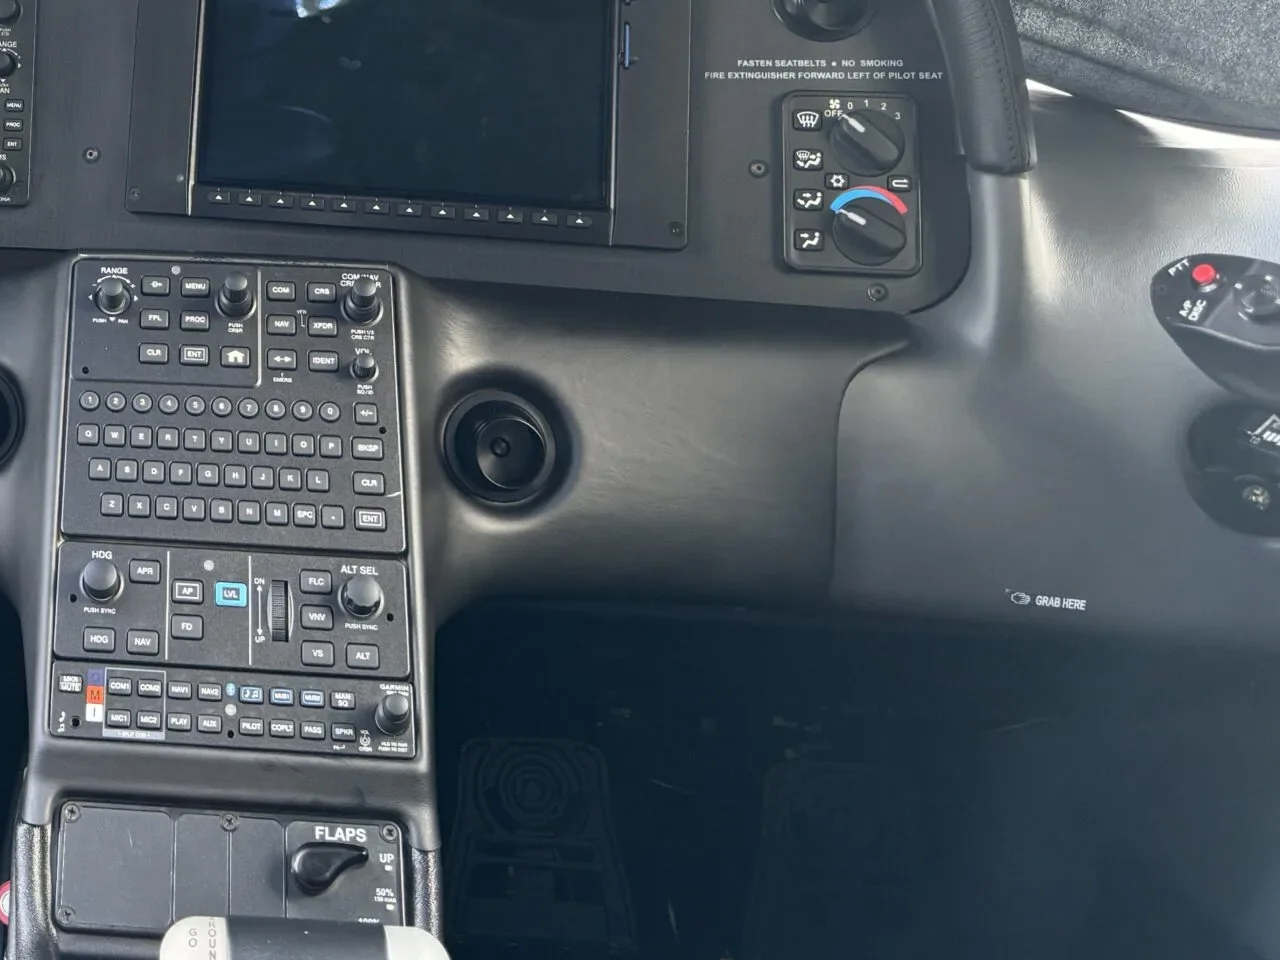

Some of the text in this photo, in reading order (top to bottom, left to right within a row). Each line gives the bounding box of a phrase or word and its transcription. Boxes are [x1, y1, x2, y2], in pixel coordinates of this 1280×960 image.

[847, 102, 853, 110] 0
[895, 112, 901, 120] 3
[1168, 259, 1189, 276] PTT
[1188, 300, 1207, 322] DISC
[205, 470, 212, 478] G
[92, 551, 113, 560] HDG
[136, 566, 153, 575] APR
[340, 565, 379, 575] ALT SEL
[1035, 595, 1087, 611] GRAB HERE
[309, 613, 326, 621] VNV
[182, 622, 192, 630] FD
[90, 635, 108, 643] HDG
[134, 637, 151, 646] NAV
[312, 649, 324, 657] VS
[356, 652, 370, 660] ALT
[60, 683, 80, 691] MUTE
[90, 690, 100, 700] M
[201, 688, 219, 696] NAV2
[111, 714, 128, 722] MIC1
[171, 717, 188, 725] PLAY
[304, 726, 322, 734] PASS
[315, 826, 367, 842] FLAPS
[379, 853, 394, 863] UP
[376, 888, 394, 897] 50%
